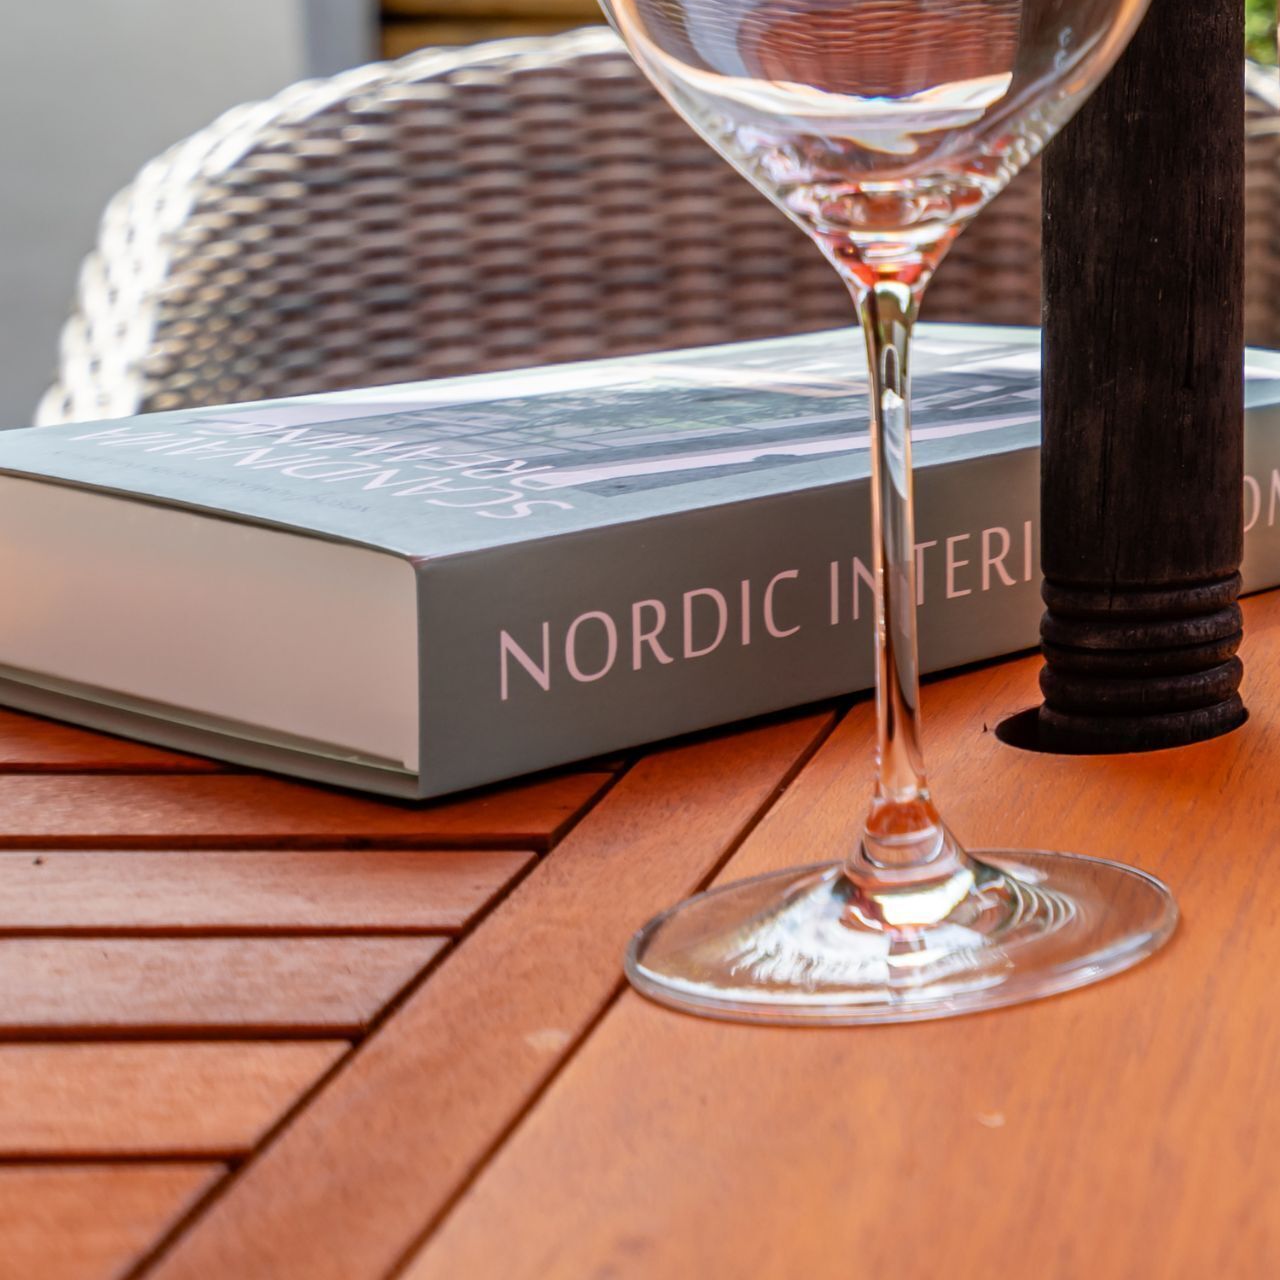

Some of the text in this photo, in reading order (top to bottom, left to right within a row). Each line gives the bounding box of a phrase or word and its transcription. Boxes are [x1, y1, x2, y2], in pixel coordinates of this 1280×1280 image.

[67, 427, 575, 519] SCANDINAVIA
[194, 422, 555, 492] DREAMING
[500, 569, 800, 701] NORDIC
